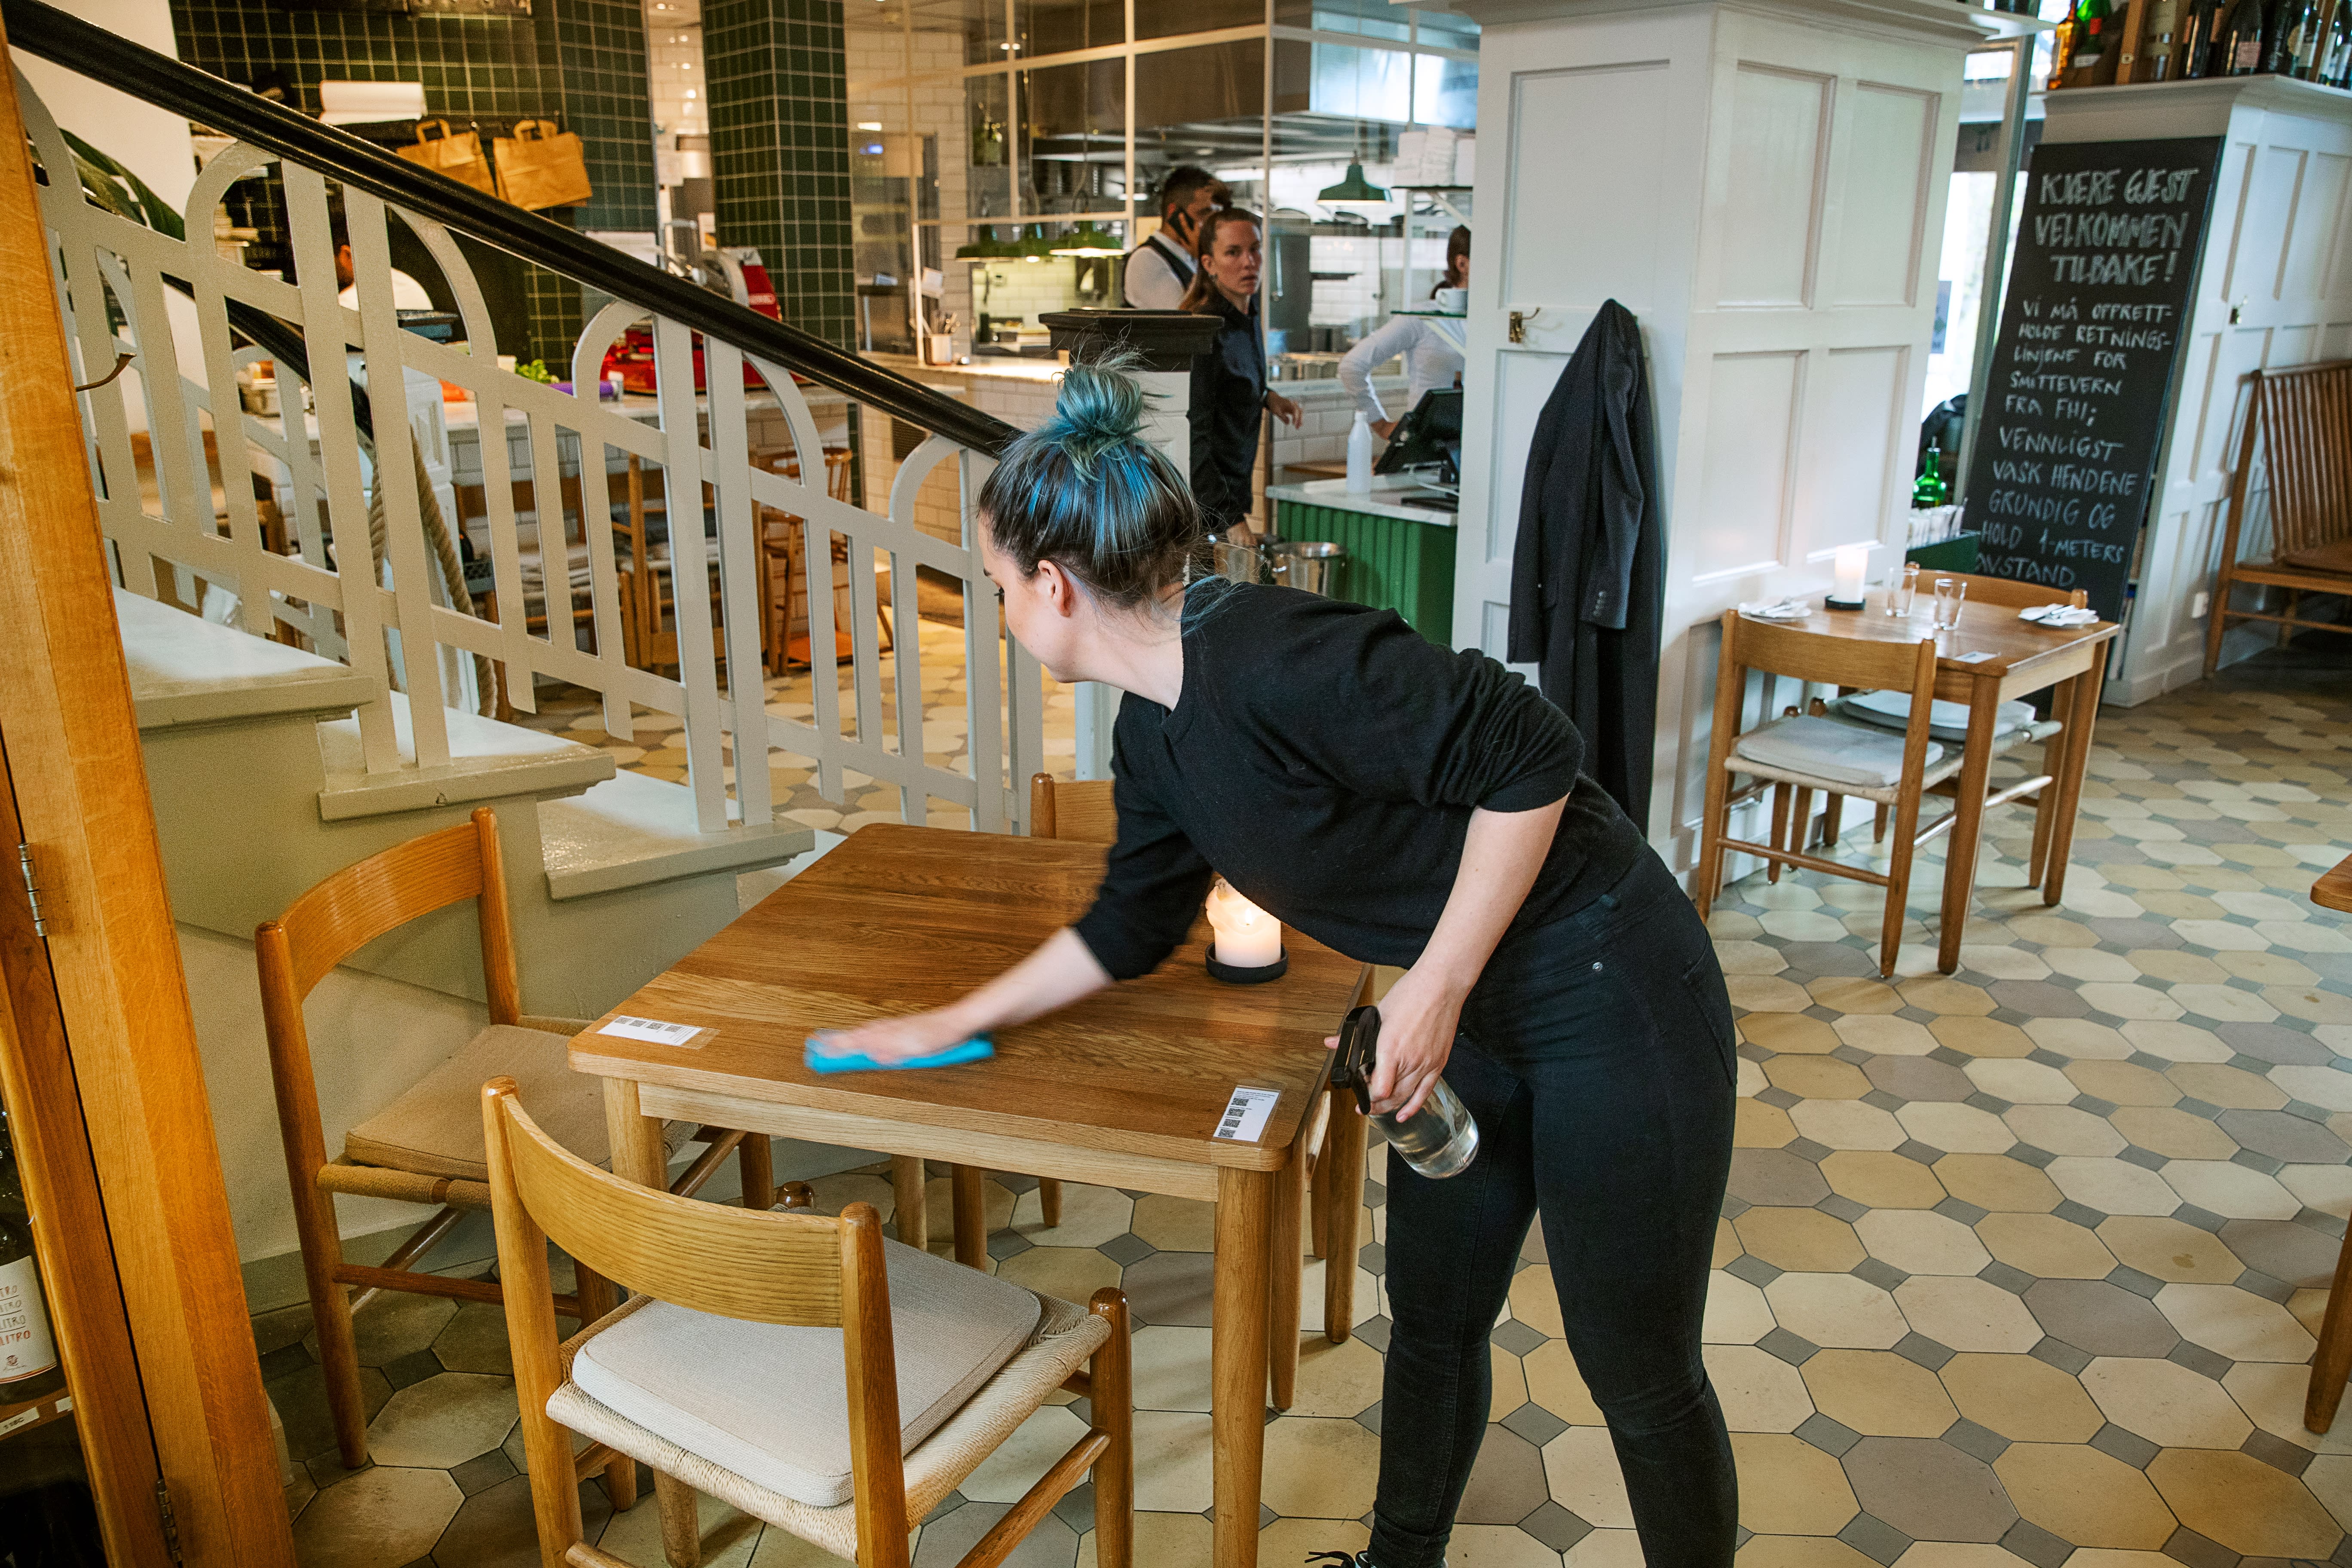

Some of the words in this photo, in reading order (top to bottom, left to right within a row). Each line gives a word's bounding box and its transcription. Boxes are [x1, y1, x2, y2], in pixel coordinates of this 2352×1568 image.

[2035, 211, 2190, 249] VELKOMMEN
[2050, 251, 2177, 285] TILBAKE!
[2019, 323, 2065, 340] HOLDE
[2093, 350, 2127, 370] FOR
[2006, 393, 2042, 416] FRA
[2000, 426, 2125, 462] VENNLIGST
[1993, 460, 2042, 485] VASK
[2051, 463, 2138, 496] HENDENE
[1988, 489, 2080, 526] GRUNDIG
[2088, 503, 2116, 530] OG
[1981, 520, 2022, 550] HOLD
[1975, 551, 2076, 587] AVSTAND
